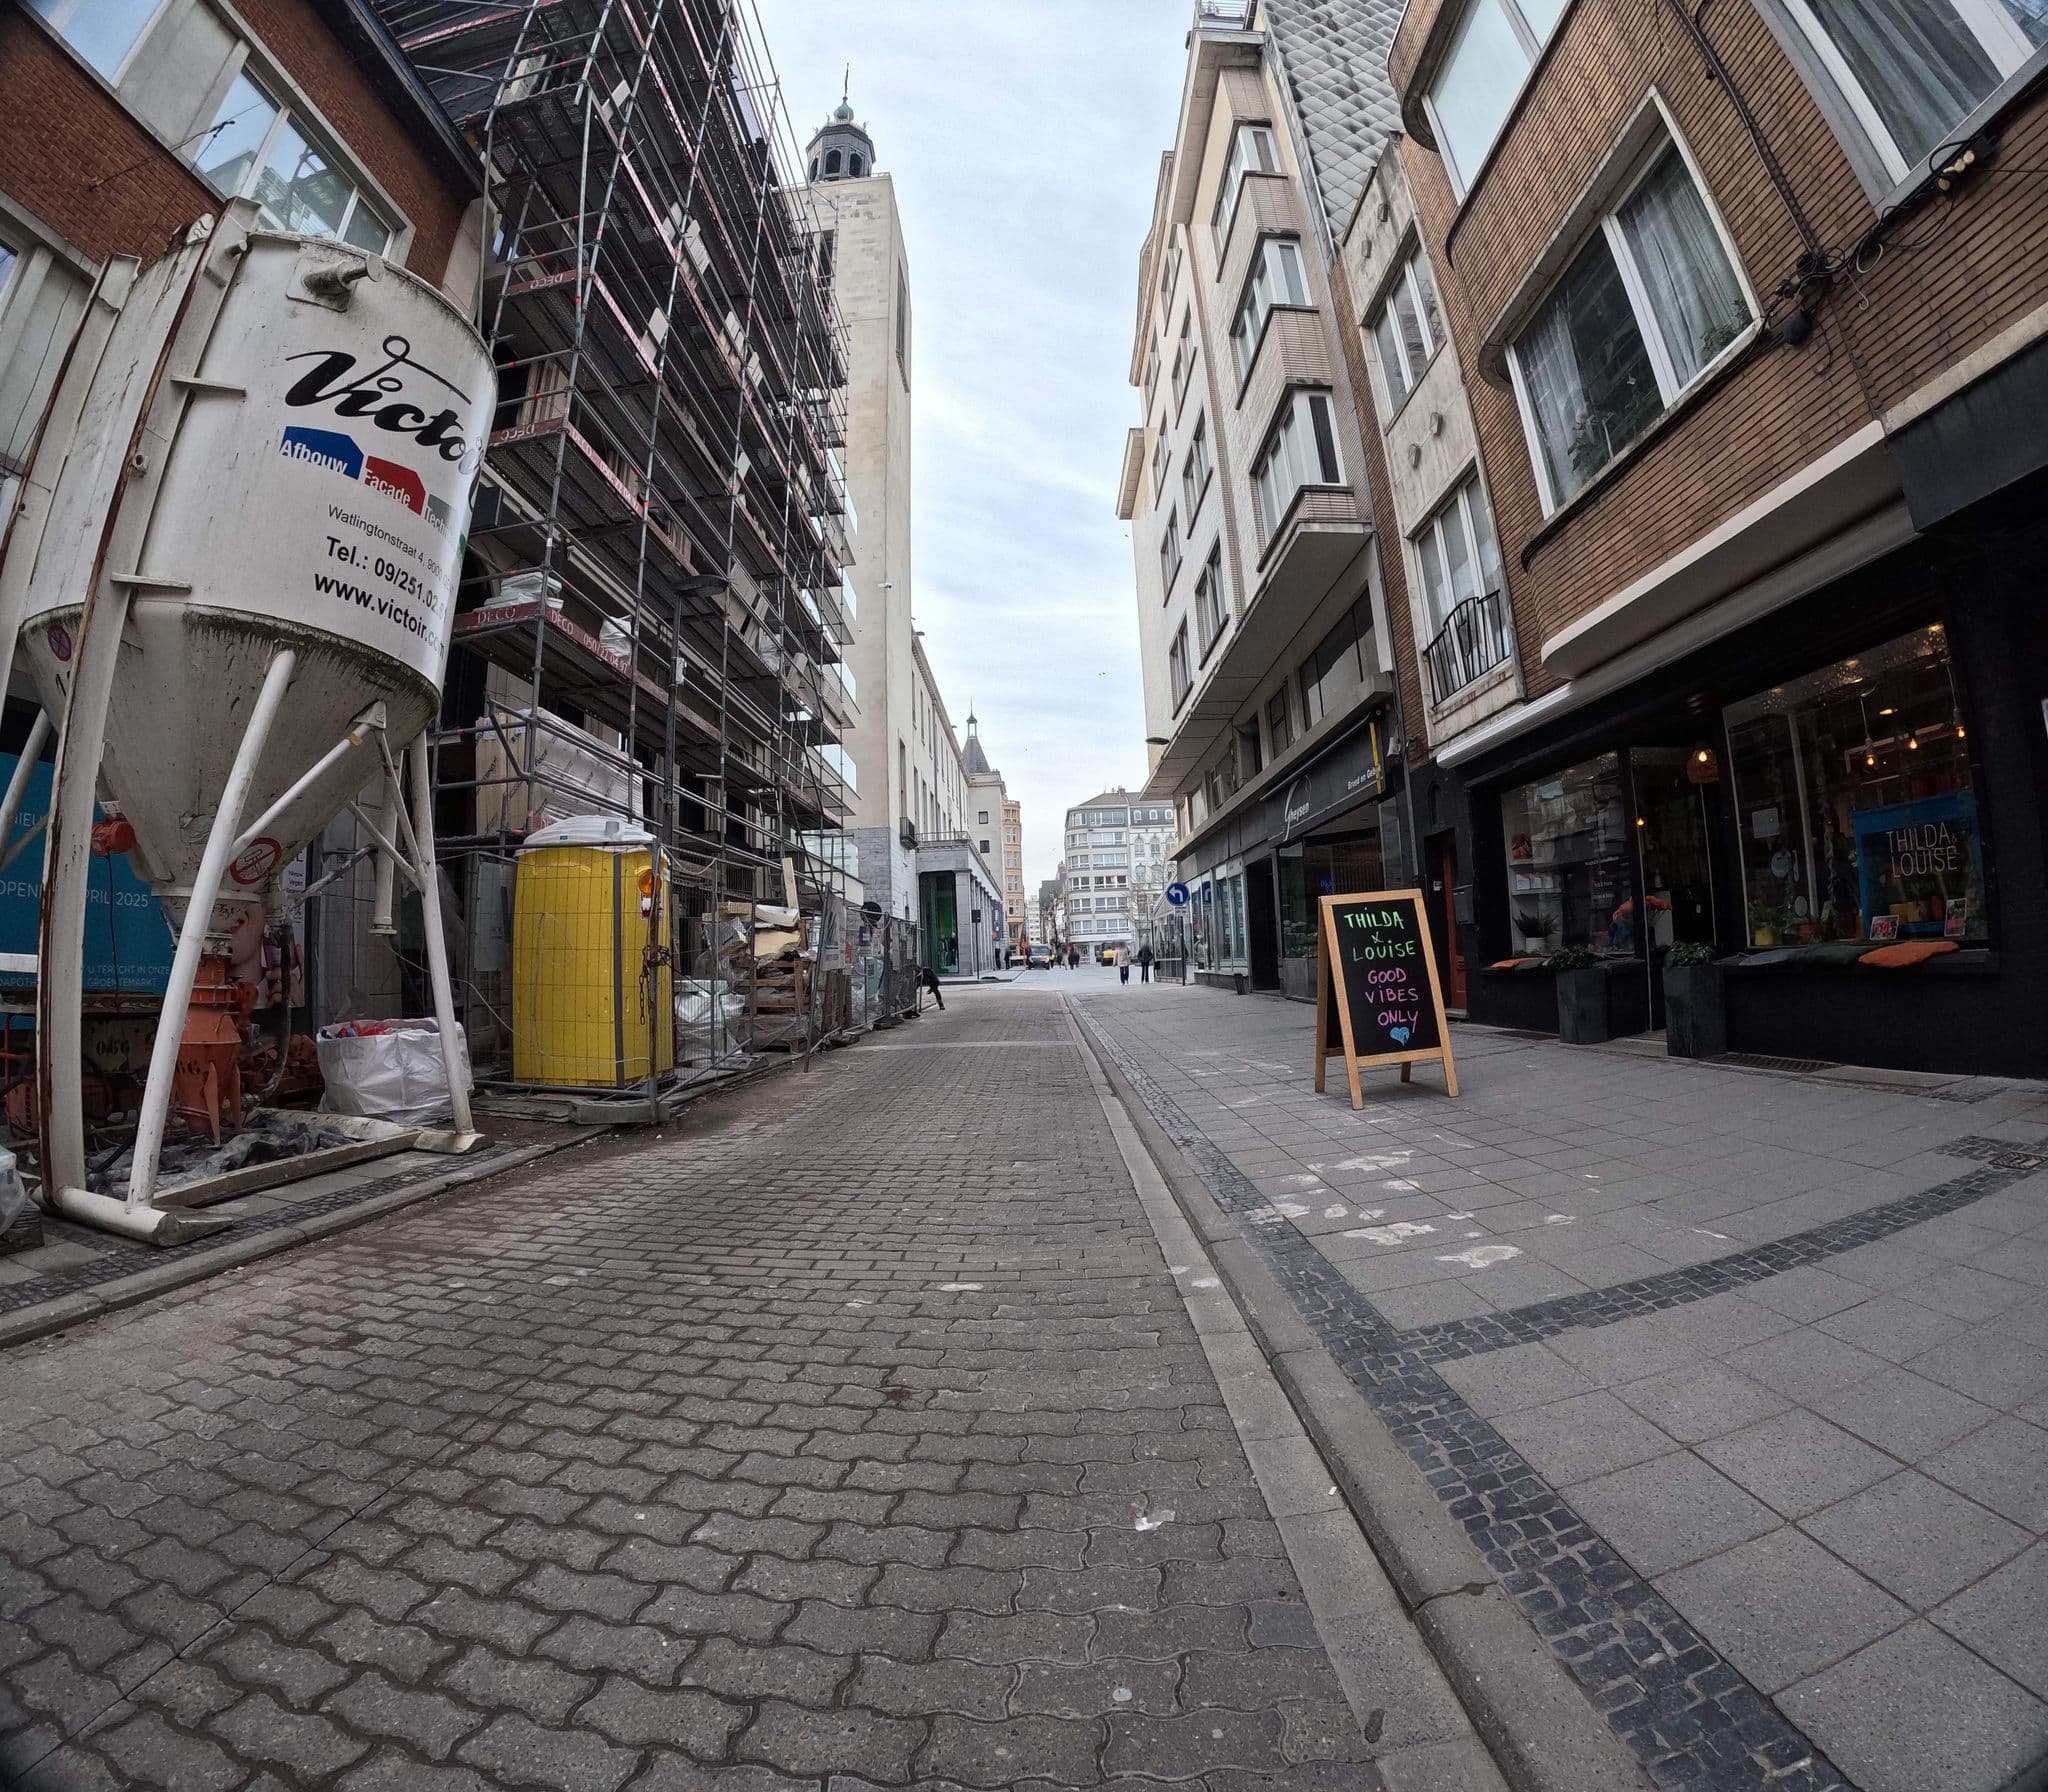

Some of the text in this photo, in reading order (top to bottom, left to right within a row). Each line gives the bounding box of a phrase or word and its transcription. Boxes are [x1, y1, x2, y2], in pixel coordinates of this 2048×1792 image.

[280, 439, 348, 475] Afbouw
[328, 504, 417, 560] Watlingtonstraat
[327, 536, 368, 570] Tel.:
[477, 607, 516, 625] DECO
[551, 611, 574, 635] DECO
[1885, 822, 1950, 853] THILDA
[1892, 846, 1957, 877] LOUISE
[115, 891, 149, 908] 2025
[1367, 968, 1406, 985] GOOD
[1378, 1009, 1418, 1033] ONLY
